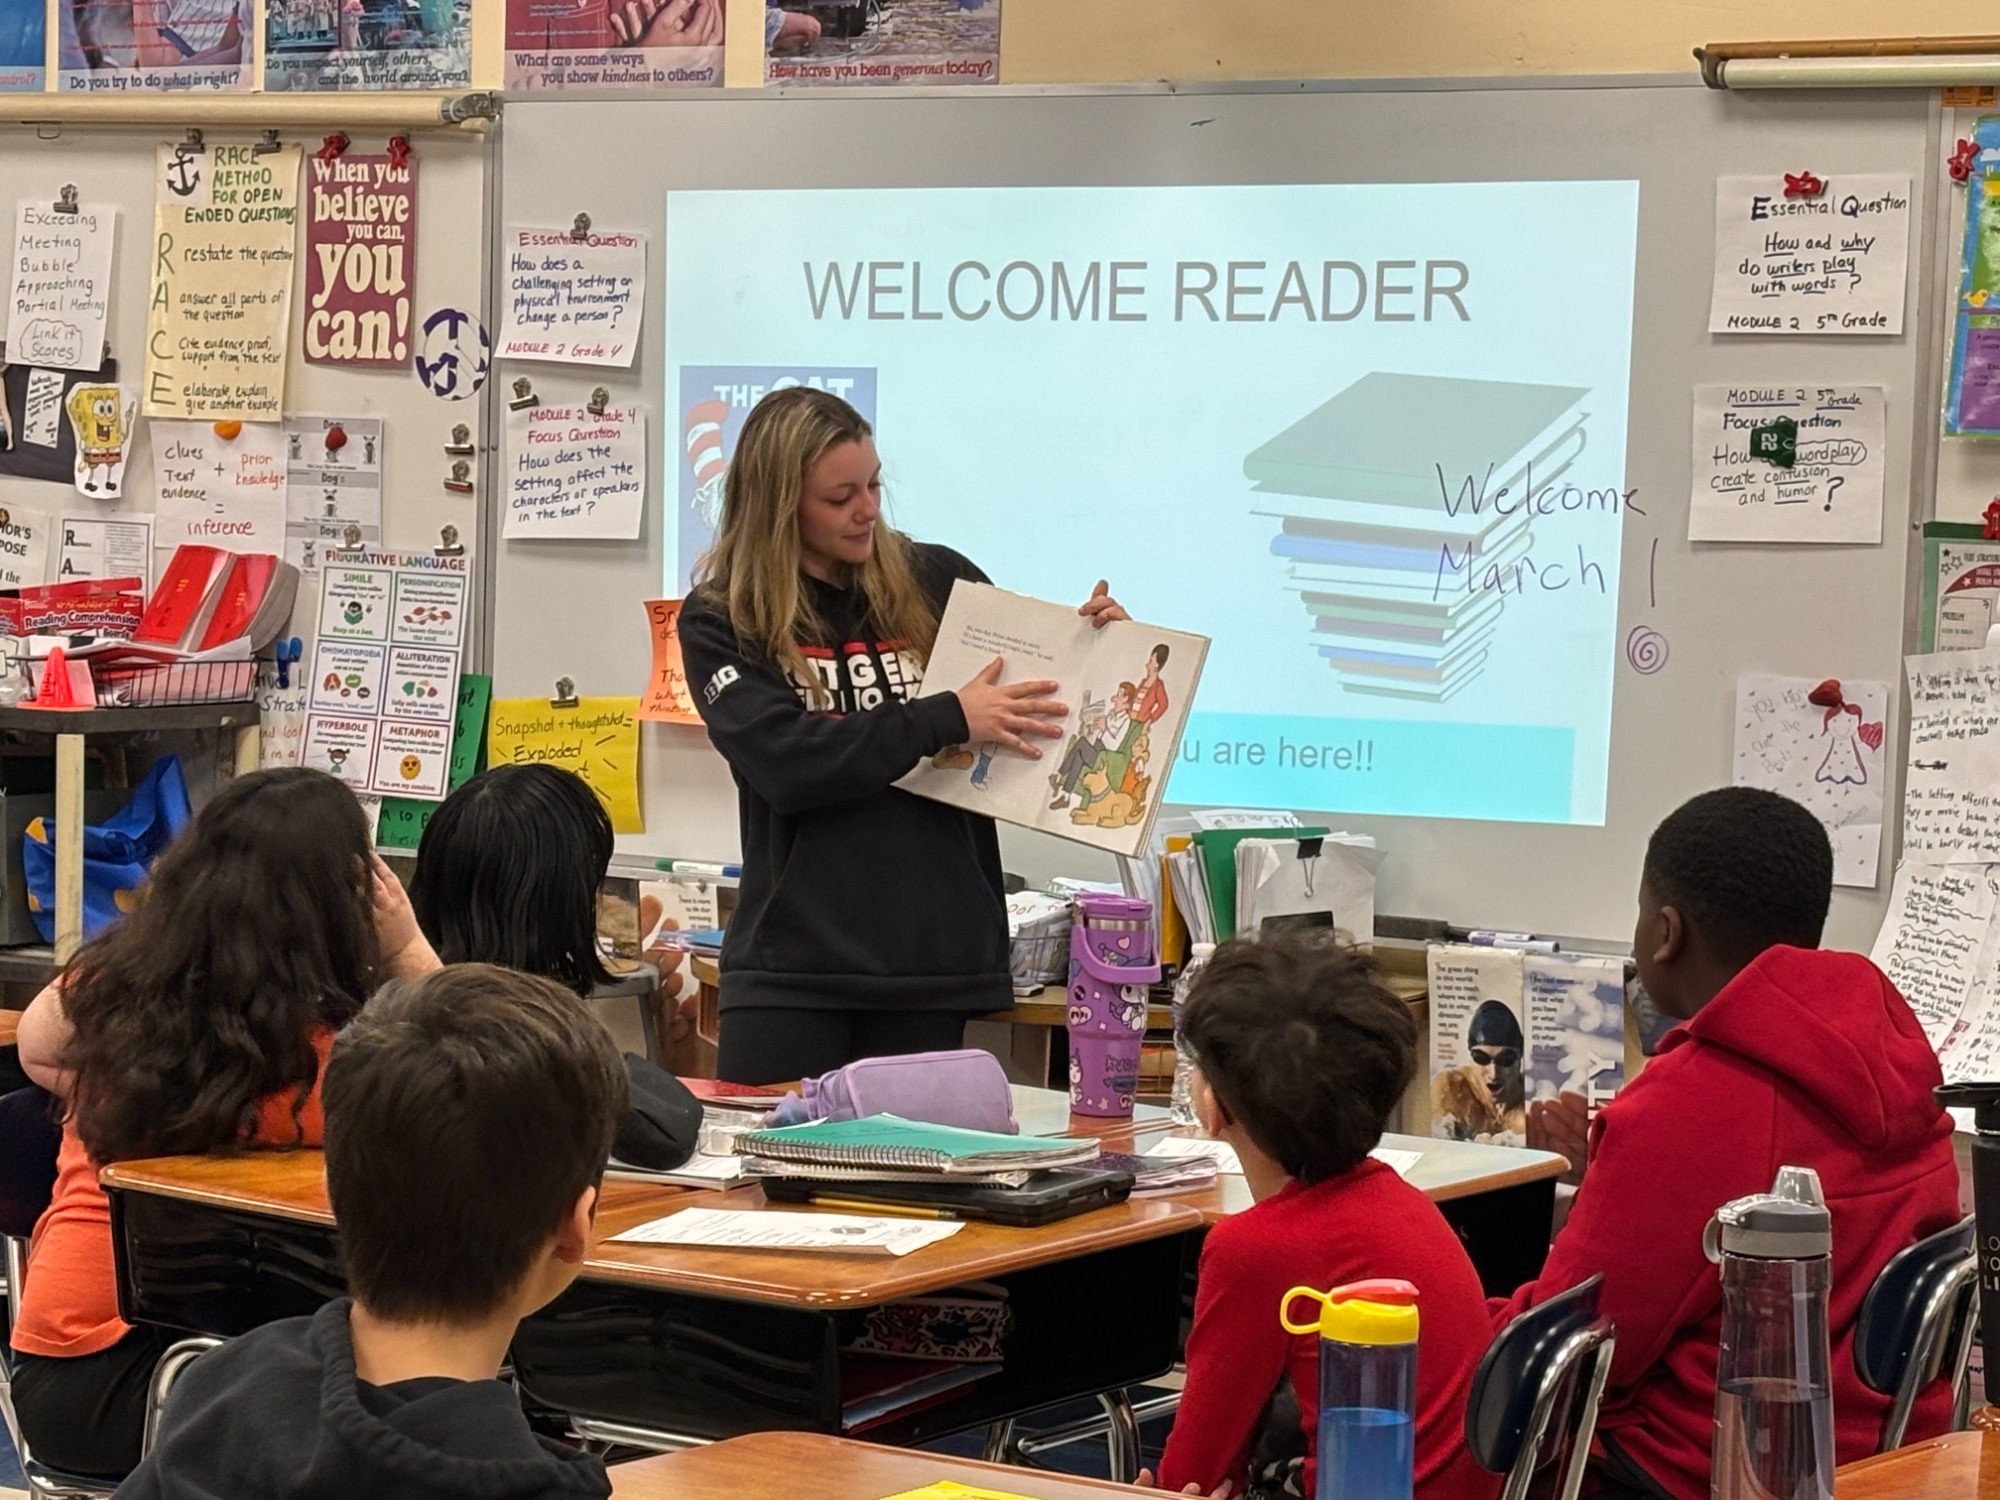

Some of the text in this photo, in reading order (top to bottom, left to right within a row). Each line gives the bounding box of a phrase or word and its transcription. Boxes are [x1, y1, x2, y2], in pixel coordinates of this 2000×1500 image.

[267, 52, 432, 71] Do you respect yourself, others,
[515, 53, 644, 68] What are some ways
[318, 70, 467, 85] and the world around you?
[542, 68, 714, 86] you show kindness to others?
[770, 61, 992, 80] How have you been generous today?
[71, 72, 239, 90] Do you try to do what is right?
[215, 147, 259, 166] RACE
[213, 167, 272, 188] METHOD
[313, 159, 410, 188] When you
[212, 188, 283, 204] FOR OPEN
[314, 186, 409, 222] believe
[185, 207, 233, 223] ENDED
[1751, 192, 1906, 220] Essential Question
[24, 208, 97, 232] Exceeding
[346, 225, 405, 244] you can,
[586, 233, 637, 248] Question
[1765, 232, 1875, 254] How and why
[157, 232, 257, 277] R restate the
[512, 253, 583, 272] How does a
[21, 258, 74, 272] Bubble
[1739, 256, 1855, 276] do play
[312, 244, 405, 308] you
[17, 278, 93, 297] Approaching
[512, 275, 616, 297] challenging setting
[802, 260, 1472, 322] WELCOME READER
[1752, 279, 1786, 294] with
[152, 281, 168, 312] A
[180, 293, 217, 305] answer
[272, 290, 284, 303] of
[514, 292, 560, 313] physical
[17, 296, 105, 319] Partial Meeting
[183, 309, 244, 322] the question
[518, 308, 556, 330] change
[1728, 311, 1887, 330] MODULE 2 Grade
[32, 324, 61, 340] Link
[307, 298, 408, 361] can!
[32, 342, 74, 360] Scores
[151, 330, 174, 359] C
[556, 344, 564, 355] 2
[571, 344, 603, 357] Grade
[611, 345, 622, 358] 4
[182, 351, 214, 365] support
[151, 371, 176, 405] E
[714, 384, 763, 407] THE
[1728, 389, 1862, 406] MODULE 2 Grade
[577, 410, 584, 422] 2
[628, 407, 636, 425] 4
[1723, 413, 1767, 430] Focus
[528, 428, 620, 444] Focus Question
[1761, 433, 1777, 451] 22
[165, 441, 203, 459] Clues
[519, 446, 610, 471] How does the
[1713, 444, 1751, 466] How
[241, 454, 272, 471] prior
[515, 462, 633, 493] setting affect the
[1711, 467, 1829, 489] create confusion
[162, 487, 206, 501] evidence
[574, 490, 586, 499] or
[1436, 461, 1646, 517] Welcome
[1739, 490, 1765, 505] and
[519, 513, 529, 522] in
[188, 519, 255, 536] inference
[326, 550, 464, 571] FIGURATIVE LANGUAGE
[344, 574, 373, 584] SIMILE
[1433, 540, 1605, 602] March
[400, 578, 461, 589] PERSONIFICATION
[25, 612, 66, 629] Reading
[69, 610, 141, 625] Comprehension
[396, 652, 450, 663] ALLITERATION
[317, 720, 368, 732] HYPERBOLE
[390, 726, 439, 738] METAPHOR
[496, 717, 554, 741] Snapshot
[514, 740, 582, 763] Exploded
[1214, 736, 1373, 771] are here!!
